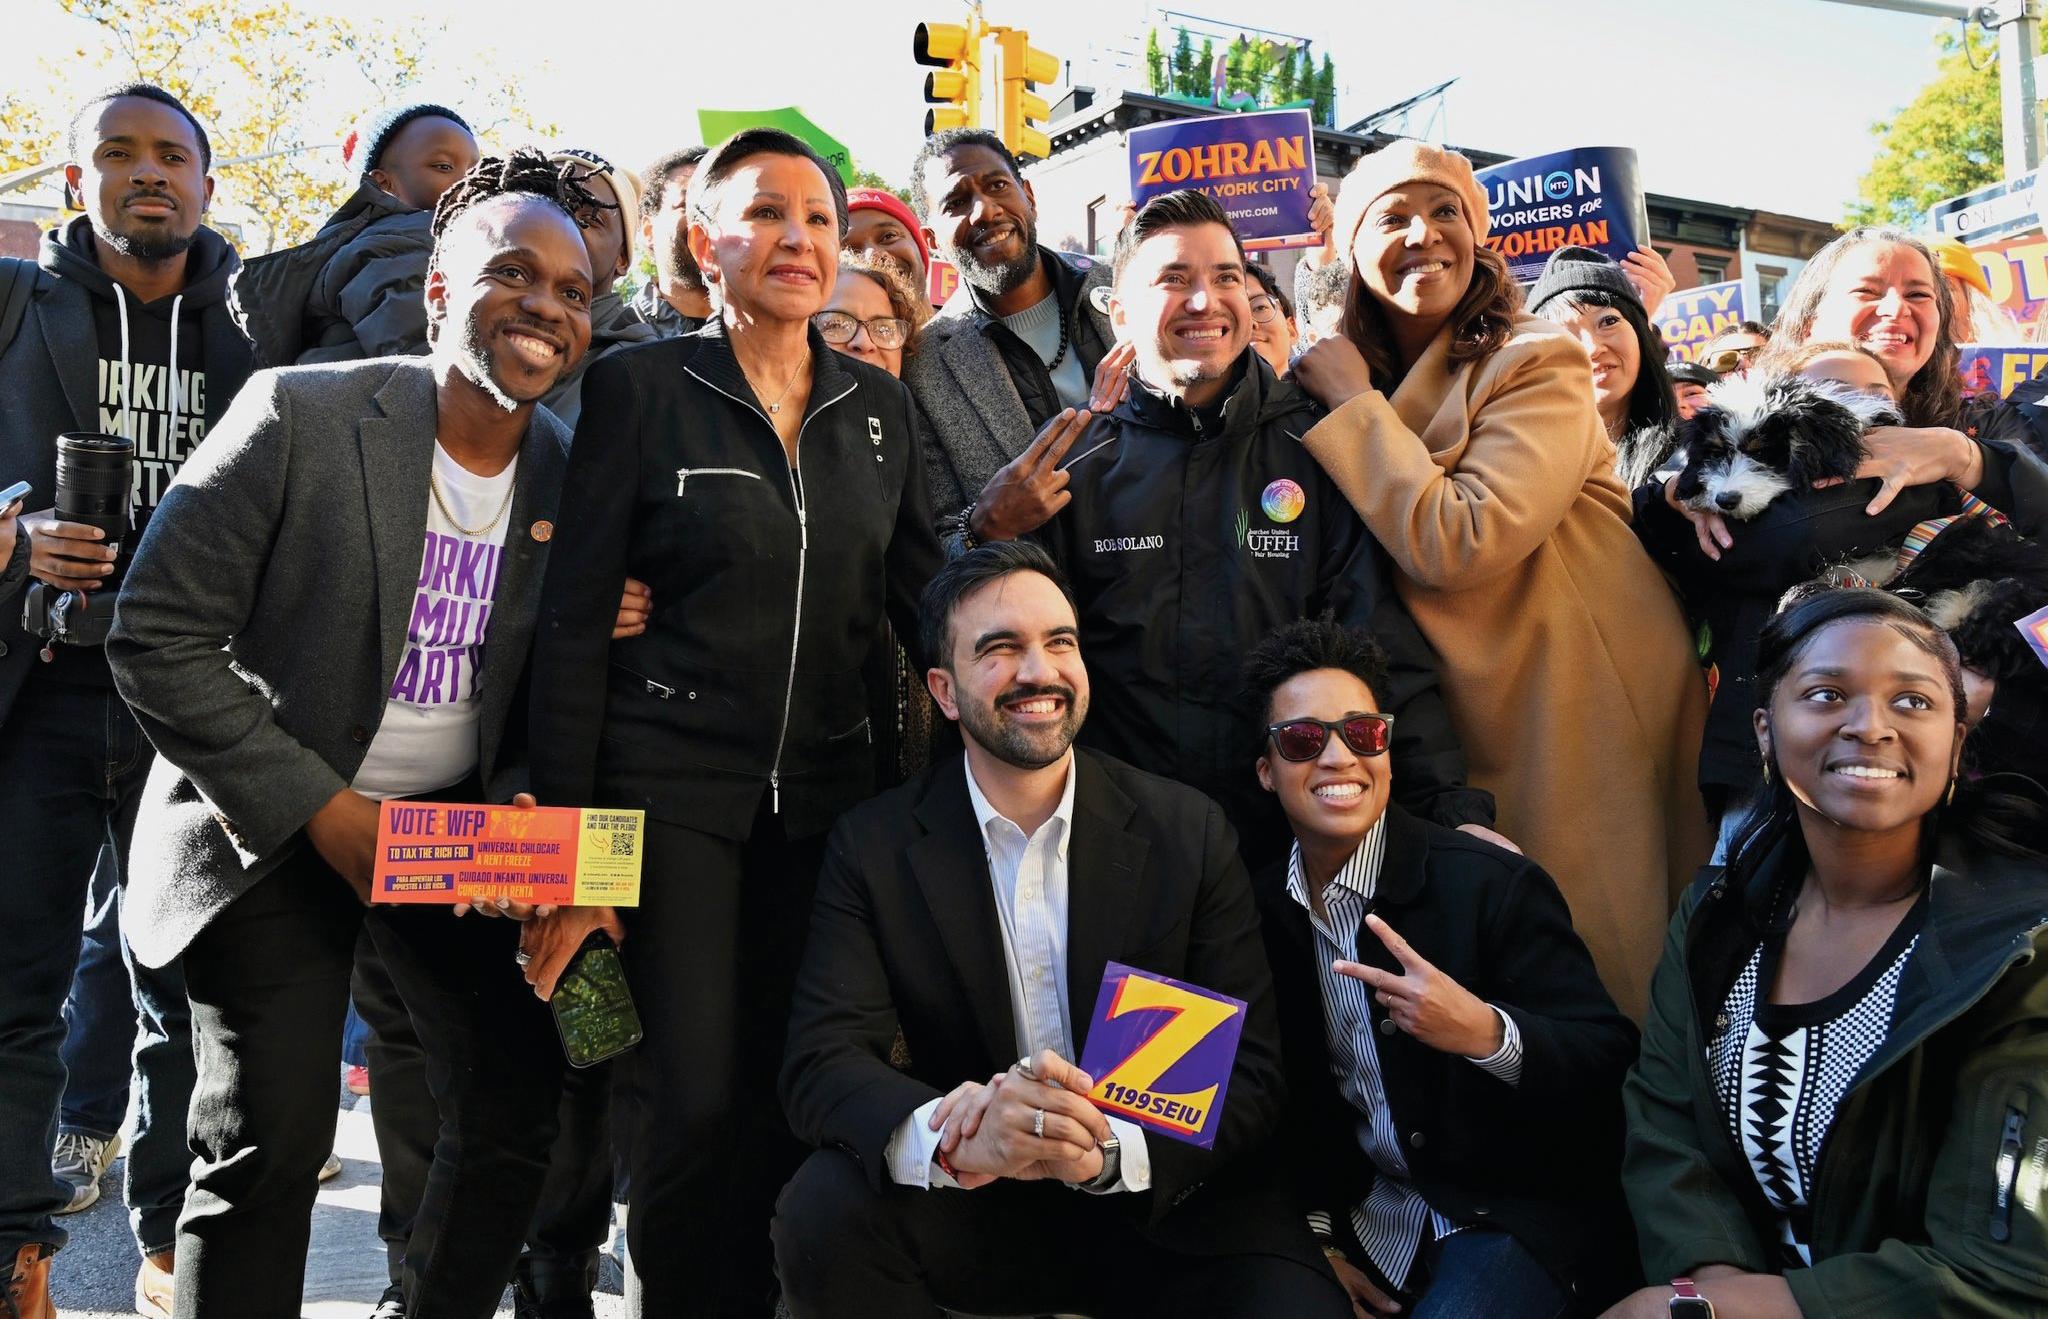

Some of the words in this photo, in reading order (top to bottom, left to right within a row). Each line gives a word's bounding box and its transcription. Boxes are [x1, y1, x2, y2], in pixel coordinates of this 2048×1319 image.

[827, 152, 845, 167] OR
[1137, 135, 1307, 186] ZOHRAN
[1213, 181, 1259, 198] YORK
[1262, 176, 1300, 193] CITY
[1488, 166, 1601, 211] UNION
[1225, 206, 1278, 220] RNYC.COM
[1489, 204, 1573, 229] WORKERS
[1579, 198, 1602, 217] FOR
[1485, 220, 1609, 258] ZOHRAN
[1971, 242, 2048, 305] OT
[1664, 286, 1737, 318] ITY
[1661, 310, 1738, 344] CAN
[99, 407, 205, 463] MILIES
[1117, 535, 1163, 551] SOLANO
[408, 592, 489, 647] MILI
[389, 647, 483, 704] ARTY
[390, 807, 437, 836] VOTE
[447, 809, 486, 837] WFP
[390, 847, 400, 859] TO
[402, 847, 417, 859] TAX
[418, 847, 433, 859] THE
[434, 846, 452, 858] RICH
[454, 846, 469, 858] FOR
[476, 855, 481, 866] A
[483, 855, 503, 866] RENT
[505, 855, 532, 867] FREEZE
[478, 842, 517, 853] UNIVERSAL
[520, 842, 560, 854] CHILDCARE
[459, 871, 491, 883] CUIDADO
[494, 872, 525, 884] INFANTIL
[528, 873, 568, 885] UNIVERSAL
[499, 885, 507, 897] LA
[510, 885, 533, 898] RENTA
[1086, 973, 1239, 1134] Z
[1104, 1082, 1202, 1126] 1199SEIU
